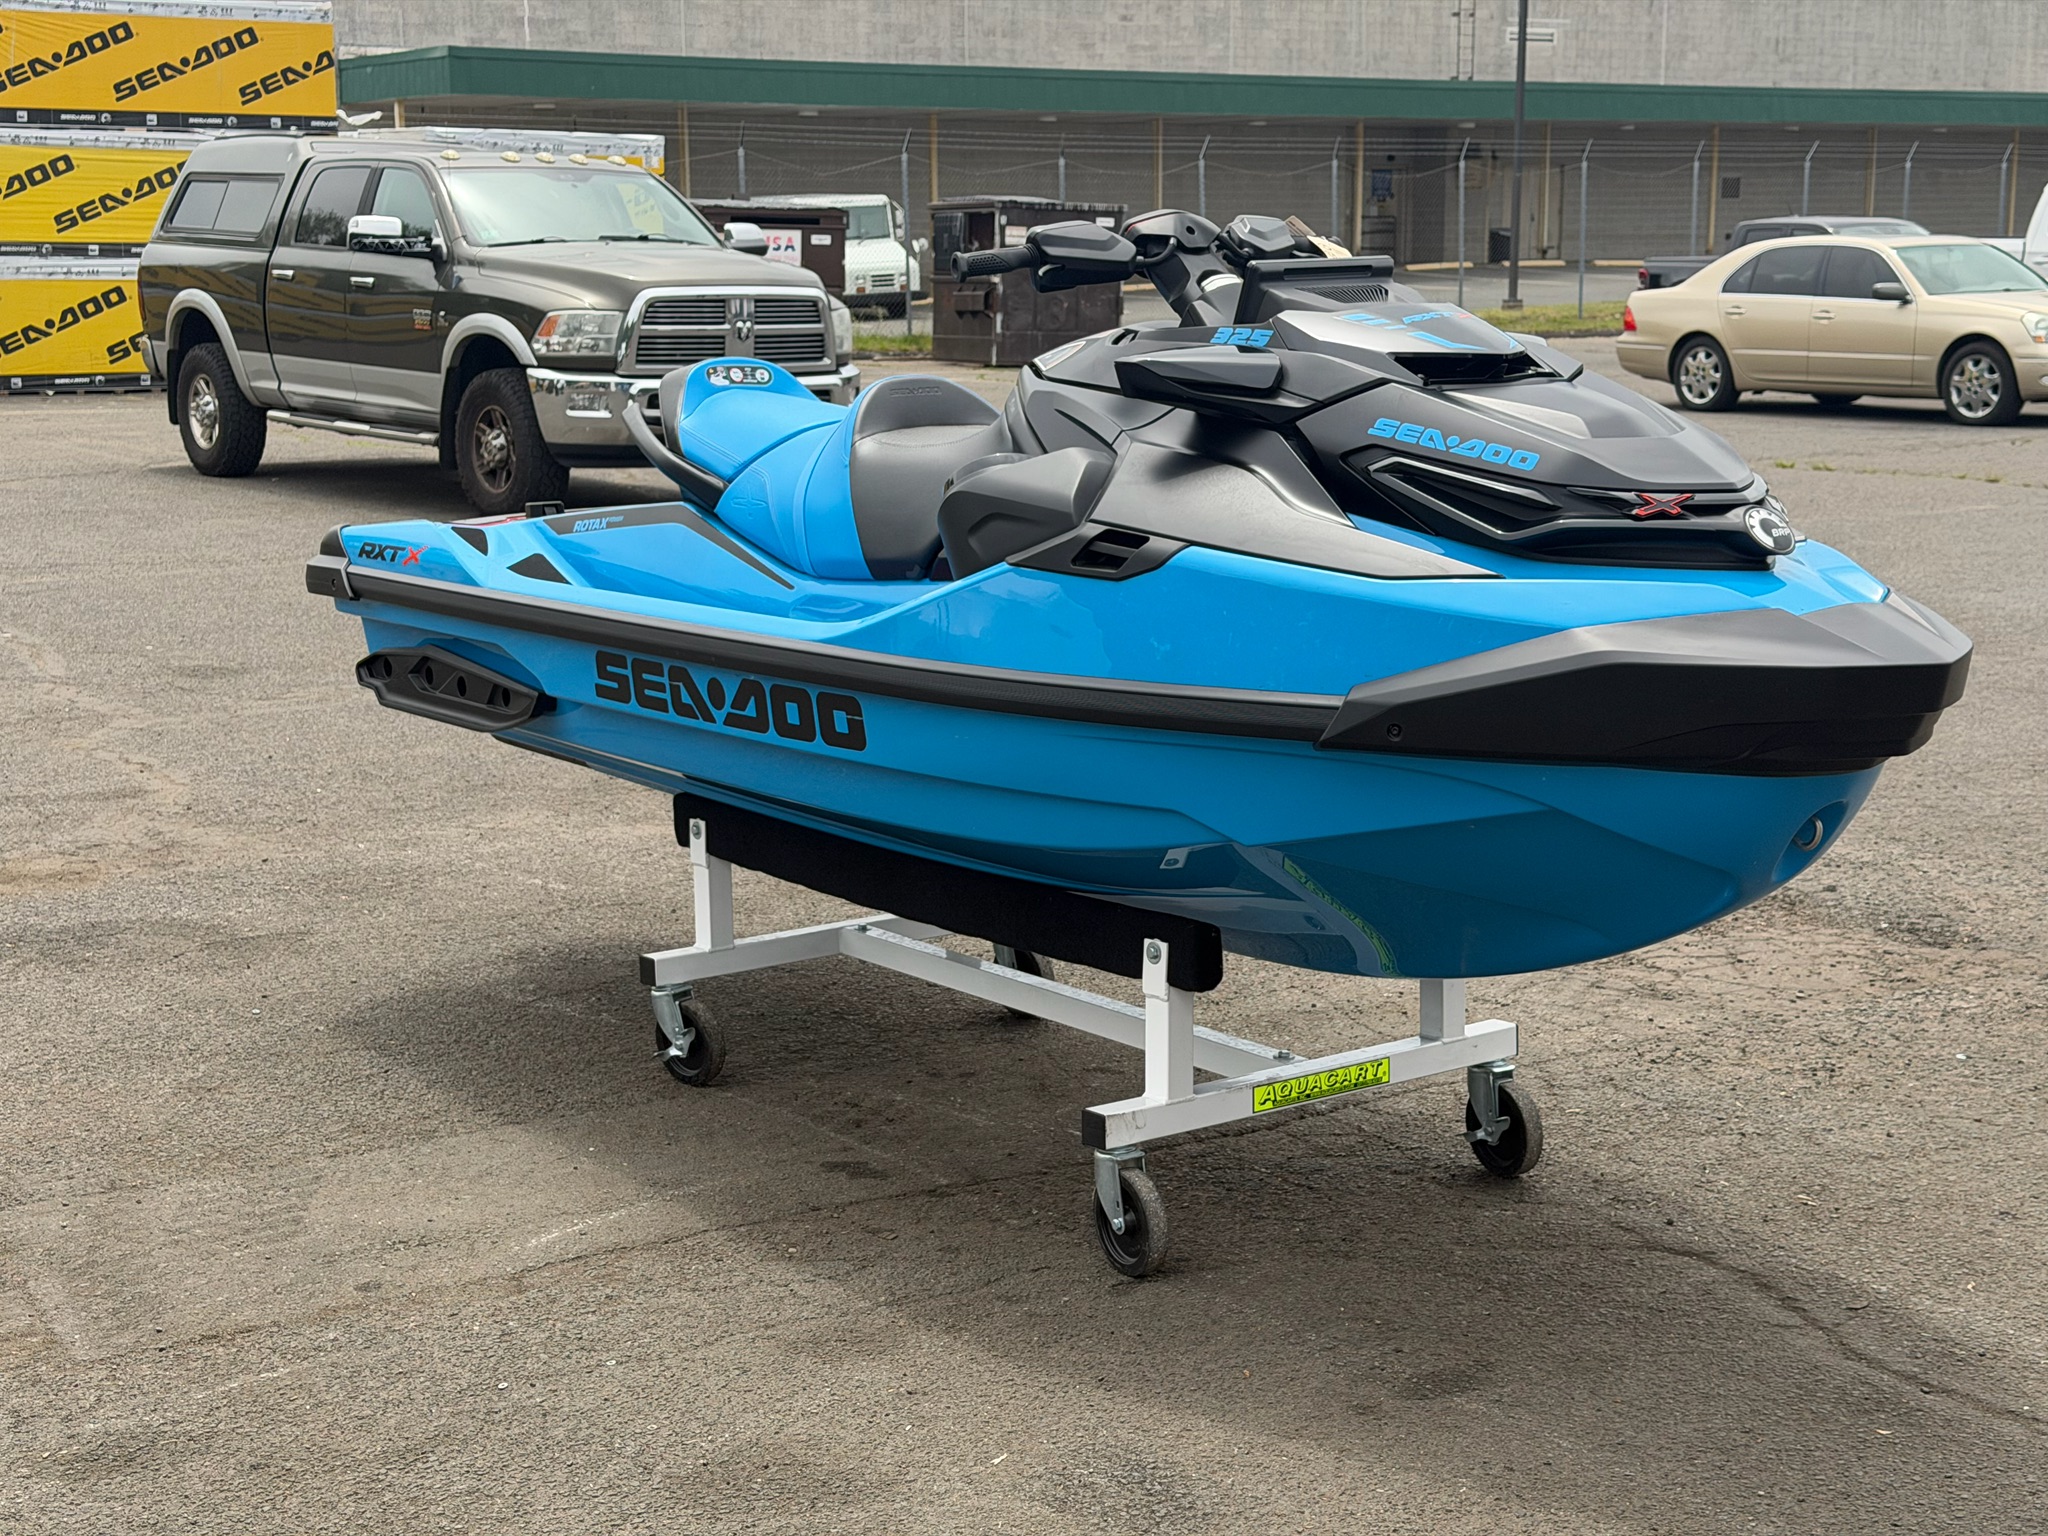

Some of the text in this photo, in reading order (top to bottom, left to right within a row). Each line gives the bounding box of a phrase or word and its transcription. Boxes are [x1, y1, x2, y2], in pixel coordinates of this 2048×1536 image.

[1210, 327, 1275, 348] 325
[573, 517, 609, 533] ROTAX
[1771, 527, 1791, 538] BRP
[357, 541, 407, 563] RXT
[1258, 1061, 1384, 1106] AQUACART
